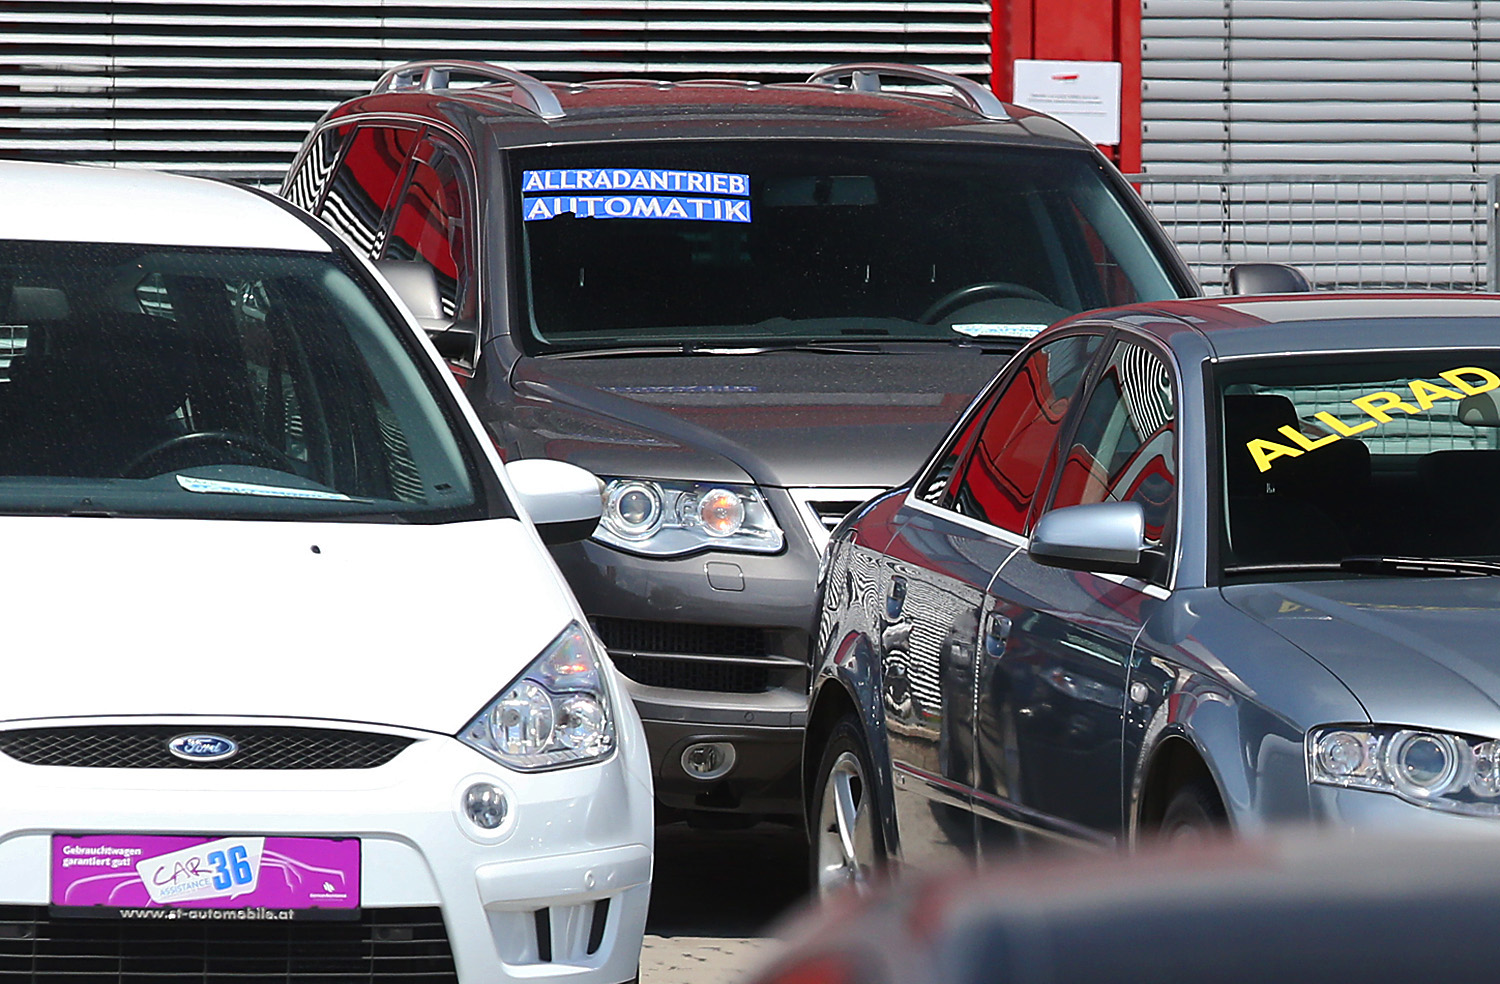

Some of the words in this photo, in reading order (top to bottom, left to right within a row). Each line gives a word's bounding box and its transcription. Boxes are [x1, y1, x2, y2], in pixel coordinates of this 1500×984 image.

[525, 170, 746, 194] ALLRADANTRIEB
[526, 197, 748, 221] AUTOMATIK
[184, 738, 221, 753] Ford
[62, 845, 142, 858] Gebrauchtwagen
[62, 857, 111, 868] garantiert
[153, 856, 213, 886] CAR
[207, 845, 252, 891] 36
